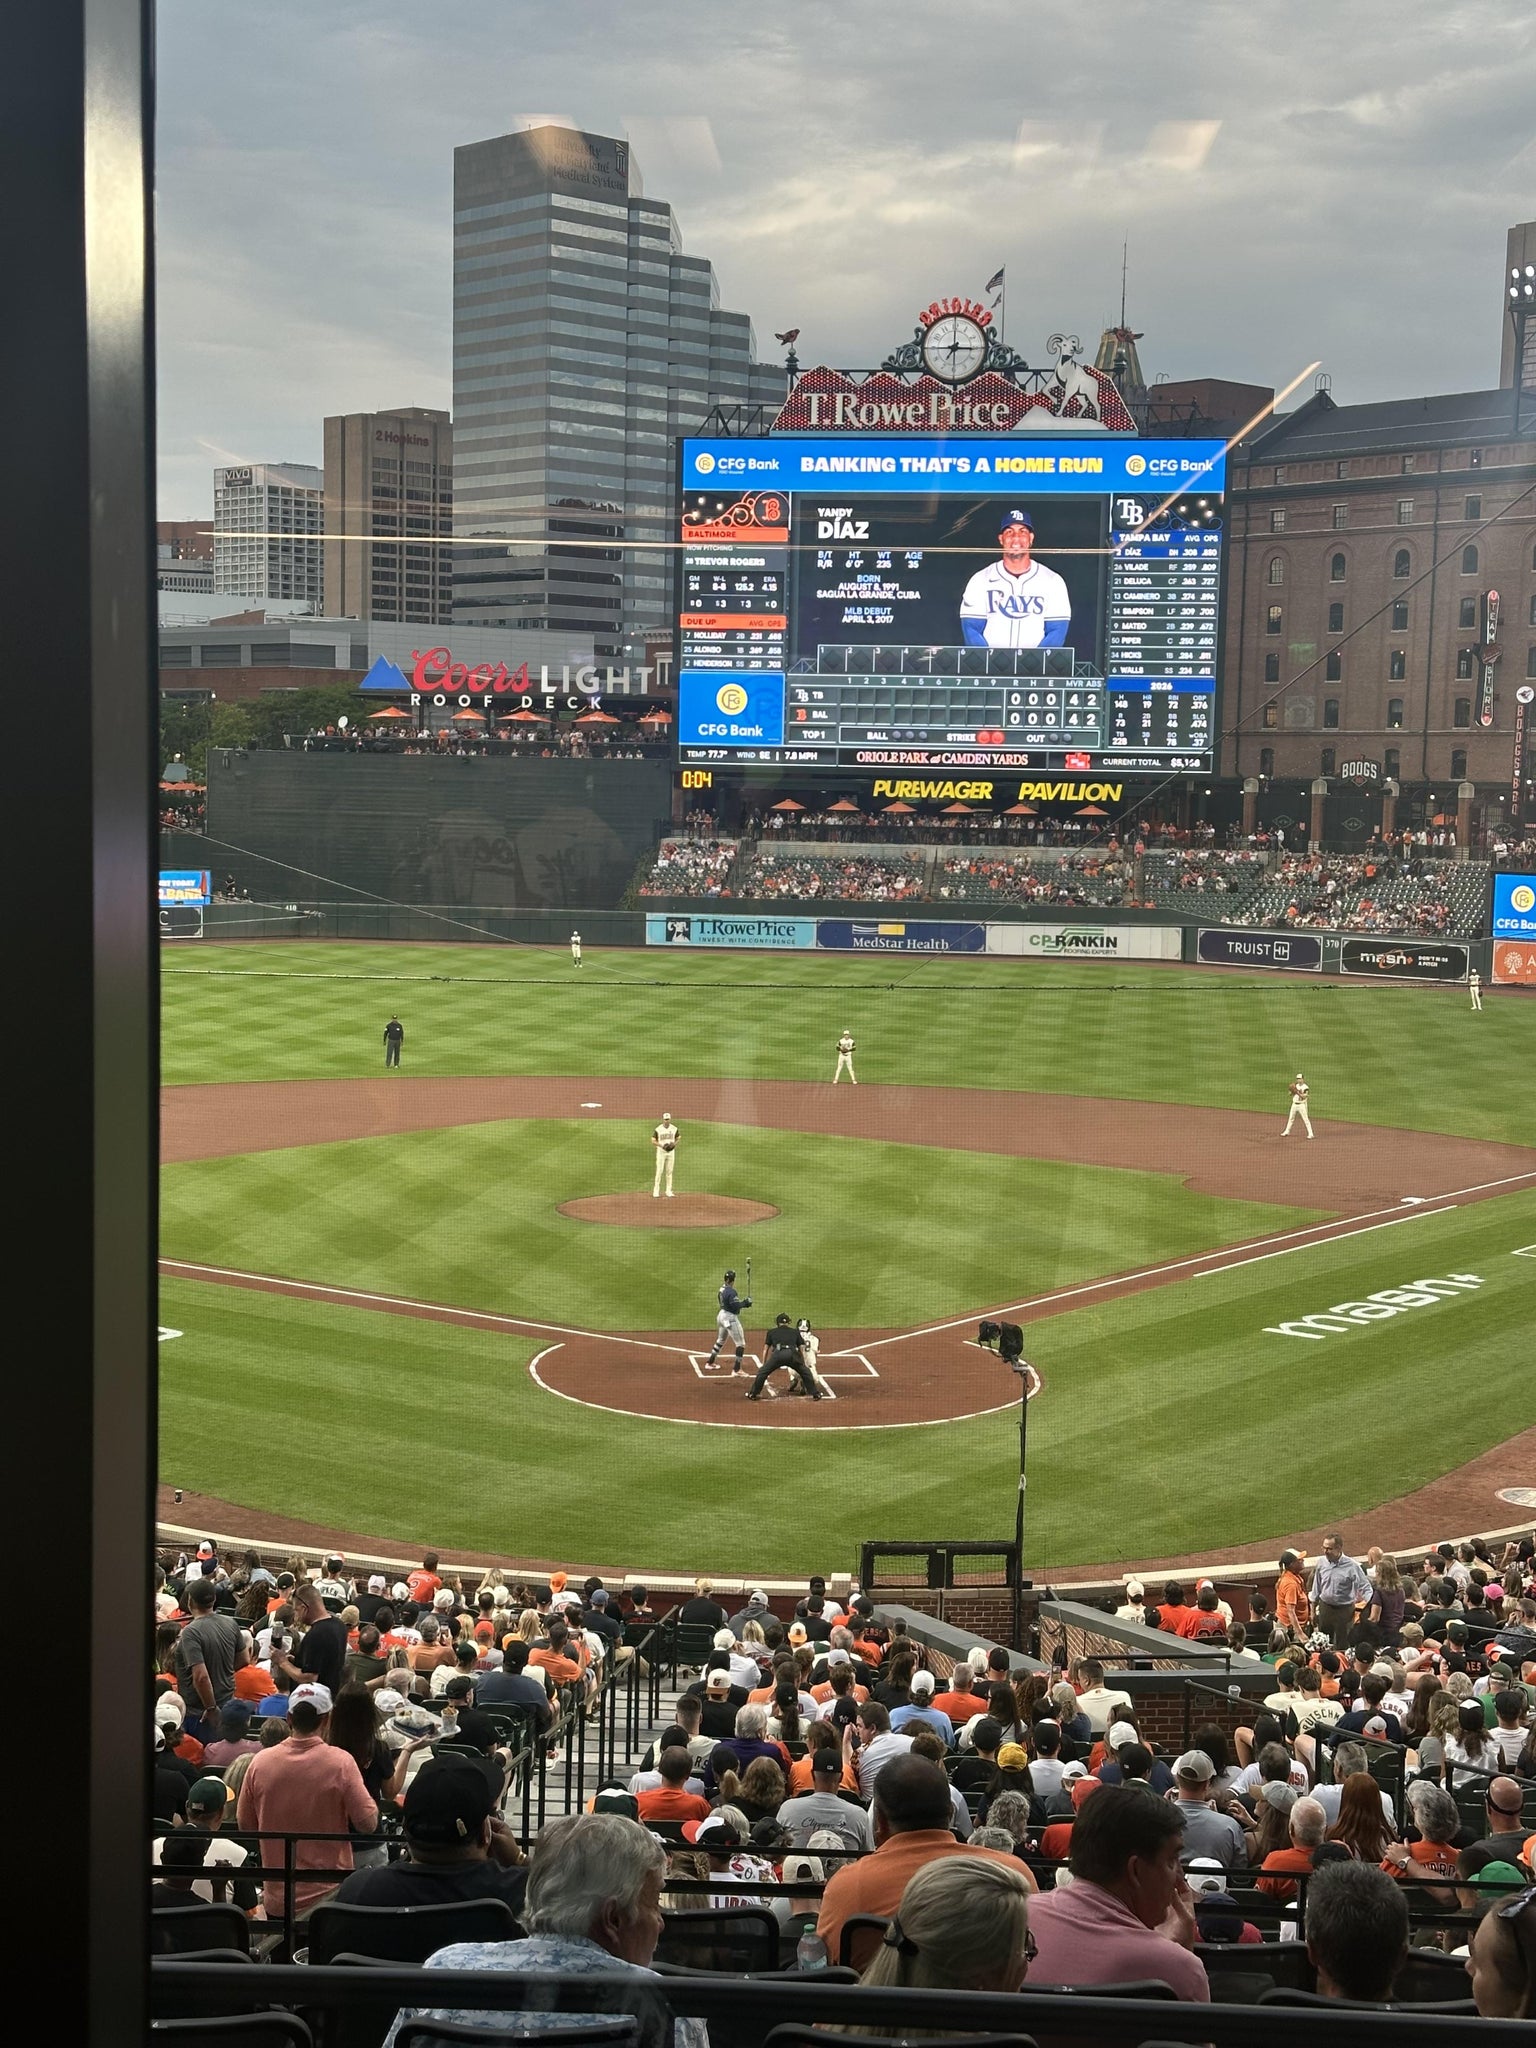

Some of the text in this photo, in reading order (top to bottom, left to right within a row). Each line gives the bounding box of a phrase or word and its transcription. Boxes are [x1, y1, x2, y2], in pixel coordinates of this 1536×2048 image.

[553, 165, 626, 190] Medical System
[919, 297, 993, 327] ORIOLES
[930, 393, 1009, 426] Price
[376, 430, 429, 446] 2 Hopkins
[718, 458, 780, 470] CFG Bank
[801, 457, 1102, 473] BANKING THAT'S A HOME RUN
[1149, 459, 1213, 472] CFG Bank
[226, 469, 250, 480] VIVO
[818, 508, 853, 518] YANDY
[818, 517, 869, 539] DÍAZ
[1119, 534, 1150, 542] TAMPA
[1152, 534, 1170, 542] BAY
[818, 551, 832, 560] B/T
[1124, 548, 1142, 556] DÍAZ
[694, 558, 766, 566] TREVOR ROGERS
[908, 560, 919, 568] 35
[762, 583, 777, 591] 4.15
[816, 590, 846, 598] SAGUA
[896, 591, 920, 599] CUBA
[986, 590, 1044, 618] RAYS
[876, 616, 894, 624] 2017
[694, 646, 722, 654] ALONSO
[694, 660, 732, 668] HENDERSON
[412, 647, 654, 694] Coors LIGHT
[1150, 682, 1173, 690] 2026
[1484, 666, 1493, 714] STORE
[411, 694, 602, 710] ROOF DECK
[812, 692, 1096, 706] TB 0 0 0 4 2
[812, 710, 1096, 726] BAL 0 0 0 4 2
[698, 724, 763, 737] CFG Bank
[802, 730, 819, 739] TOP
[866, 732, 888, 740] BALL
[947, 734, 976, 742] STRIKE
[1026, 734, 1046, 742] OUT
[687, 750, 706, 758] TEMP
[760, 752, 770, 760] SE
[799, 752, 818, 760] MPH
[856, 752, 898, 762] ORIOLE
[900, 752, 928, 763] PARK
[942, 754, 990, 764] CAMDEN
[992, 754, 1028, 766] YARDS
[1102, 758, 1137, 766] CURRENT
[1342, 762, 1377, 779] BOOGS
[682, 770, 712, 788] 0:04
[872, 780, 1122, 802] PUREWAGER PAVILION
[757, 920, 796, 936] Price
[1496, 918, 1520, 930] CFG
[853, 938, 948, 950] MedStar Health
[1227, 942, 1272, 956] TRUIST
[1325, 940, 1340, 948] 370
